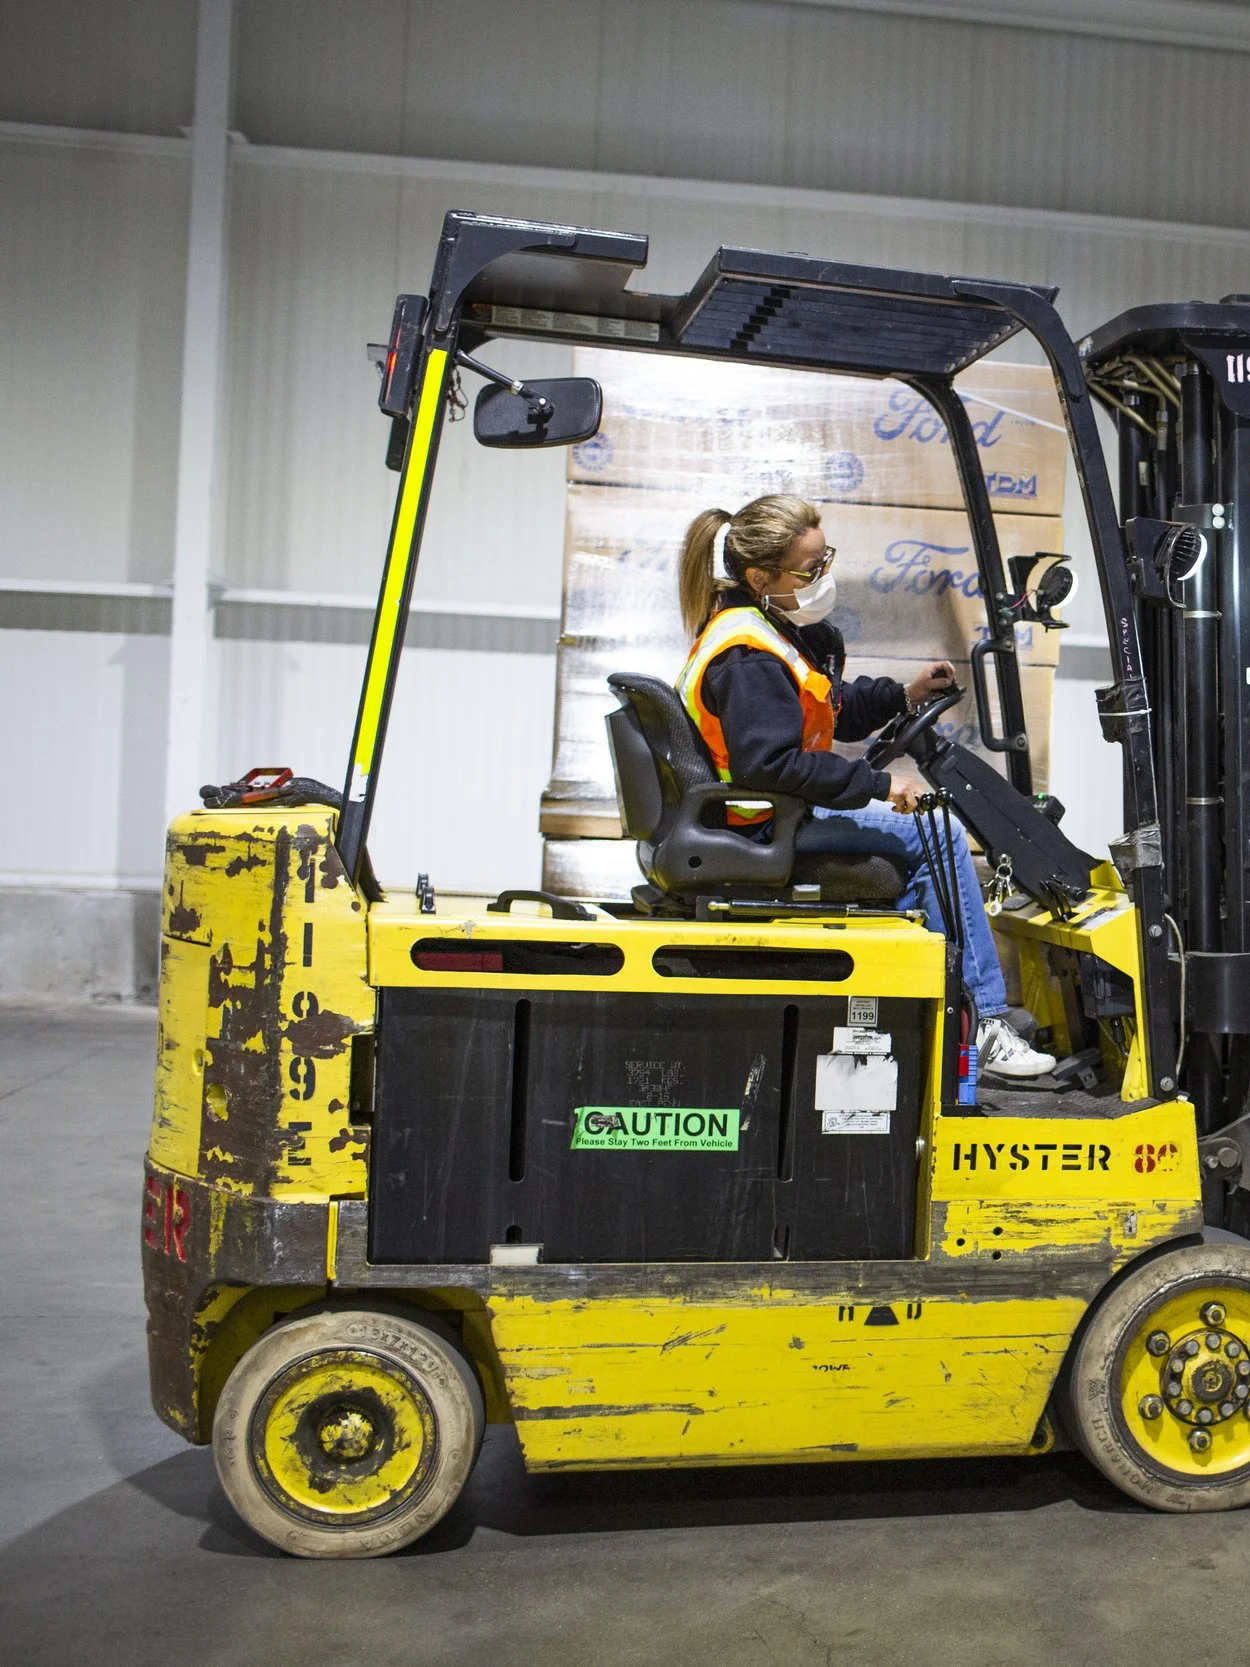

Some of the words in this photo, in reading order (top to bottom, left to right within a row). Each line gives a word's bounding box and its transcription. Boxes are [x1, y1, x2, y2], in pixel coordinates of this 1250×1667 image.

[873, 386, 1005, 447] Fod
[975, 625, 1032, 645] TM
[851, 1012, 874, 1020] 1199
[625, 1061, 665, 1069] SERVICE
[584, 1111, 728, 1137] CAUTION
[575, 1137, 605, 1146] Please
[608, 1138, 628, 1147] Stay
[953, 1144, 1111, 1171] HYSTER
